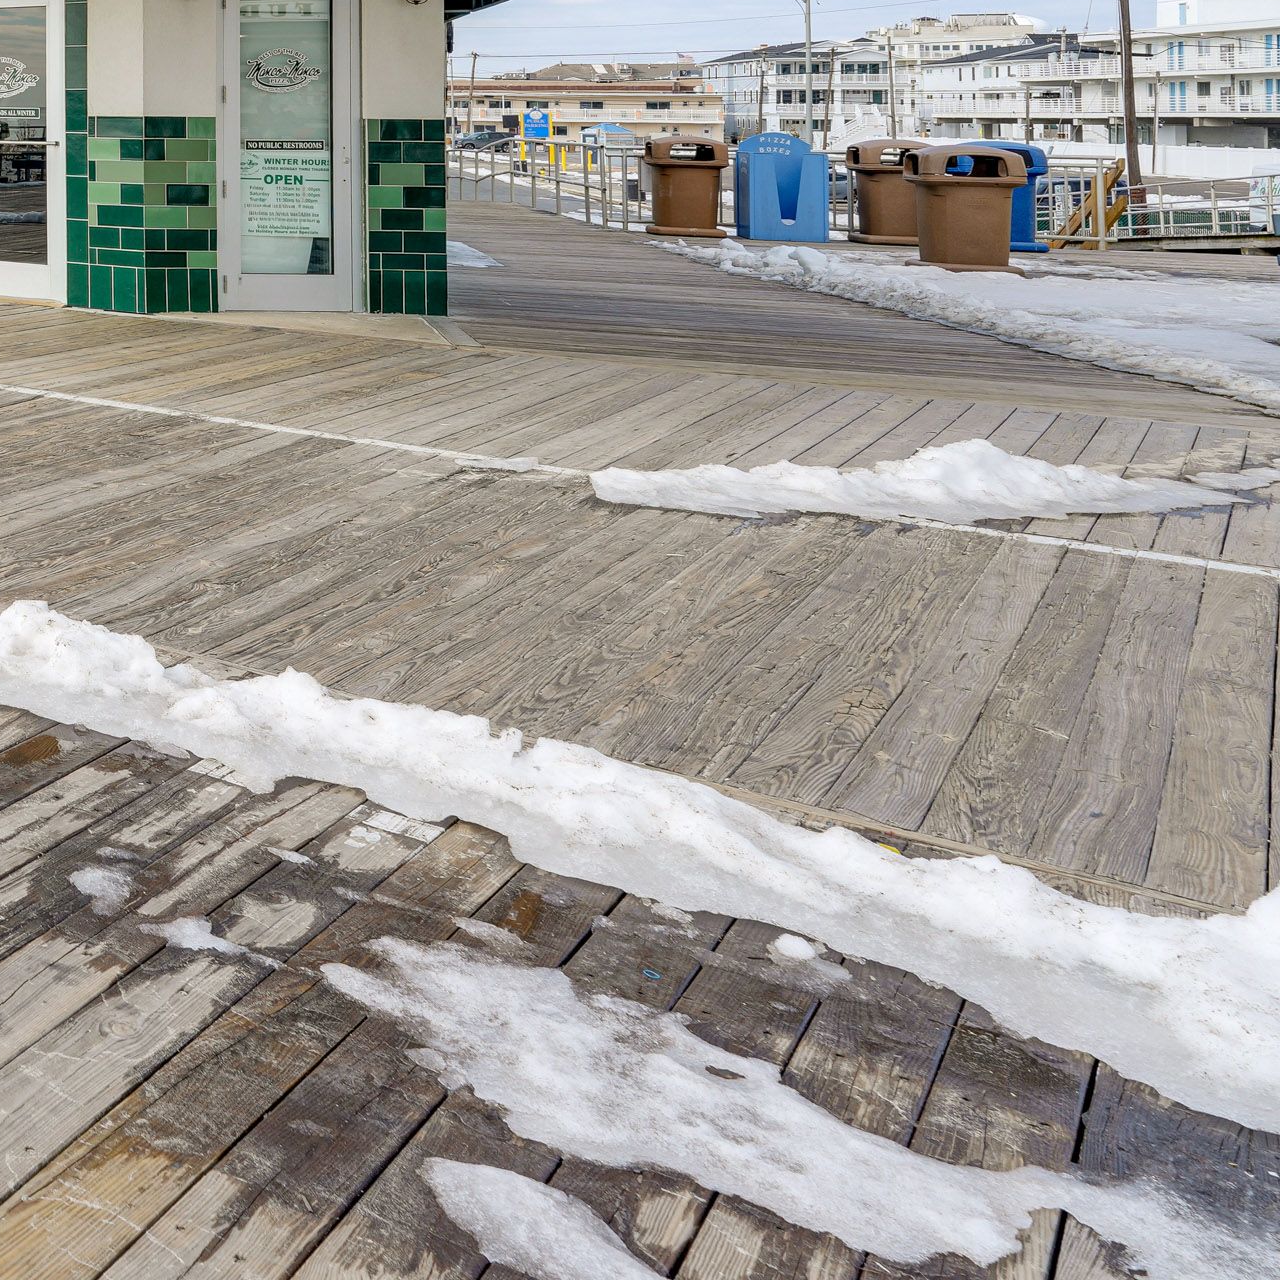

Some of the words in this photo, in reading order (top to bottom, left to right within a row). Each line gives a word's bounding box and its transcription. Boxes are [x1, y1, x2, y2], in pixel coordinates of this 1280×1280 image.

[246, 59, 282, 78] Manco
[287, 59, 321, 78] Manco
[247, 141, 258, 149] NO
[258, 141, 282, 149] PUBLIC
[759, 136, 791, 145] PIZZA
[759, 147, 791, 156] BOXES
[263, 157, 299, 165] WINTER
[263, 174, 304, 185] OPEN
